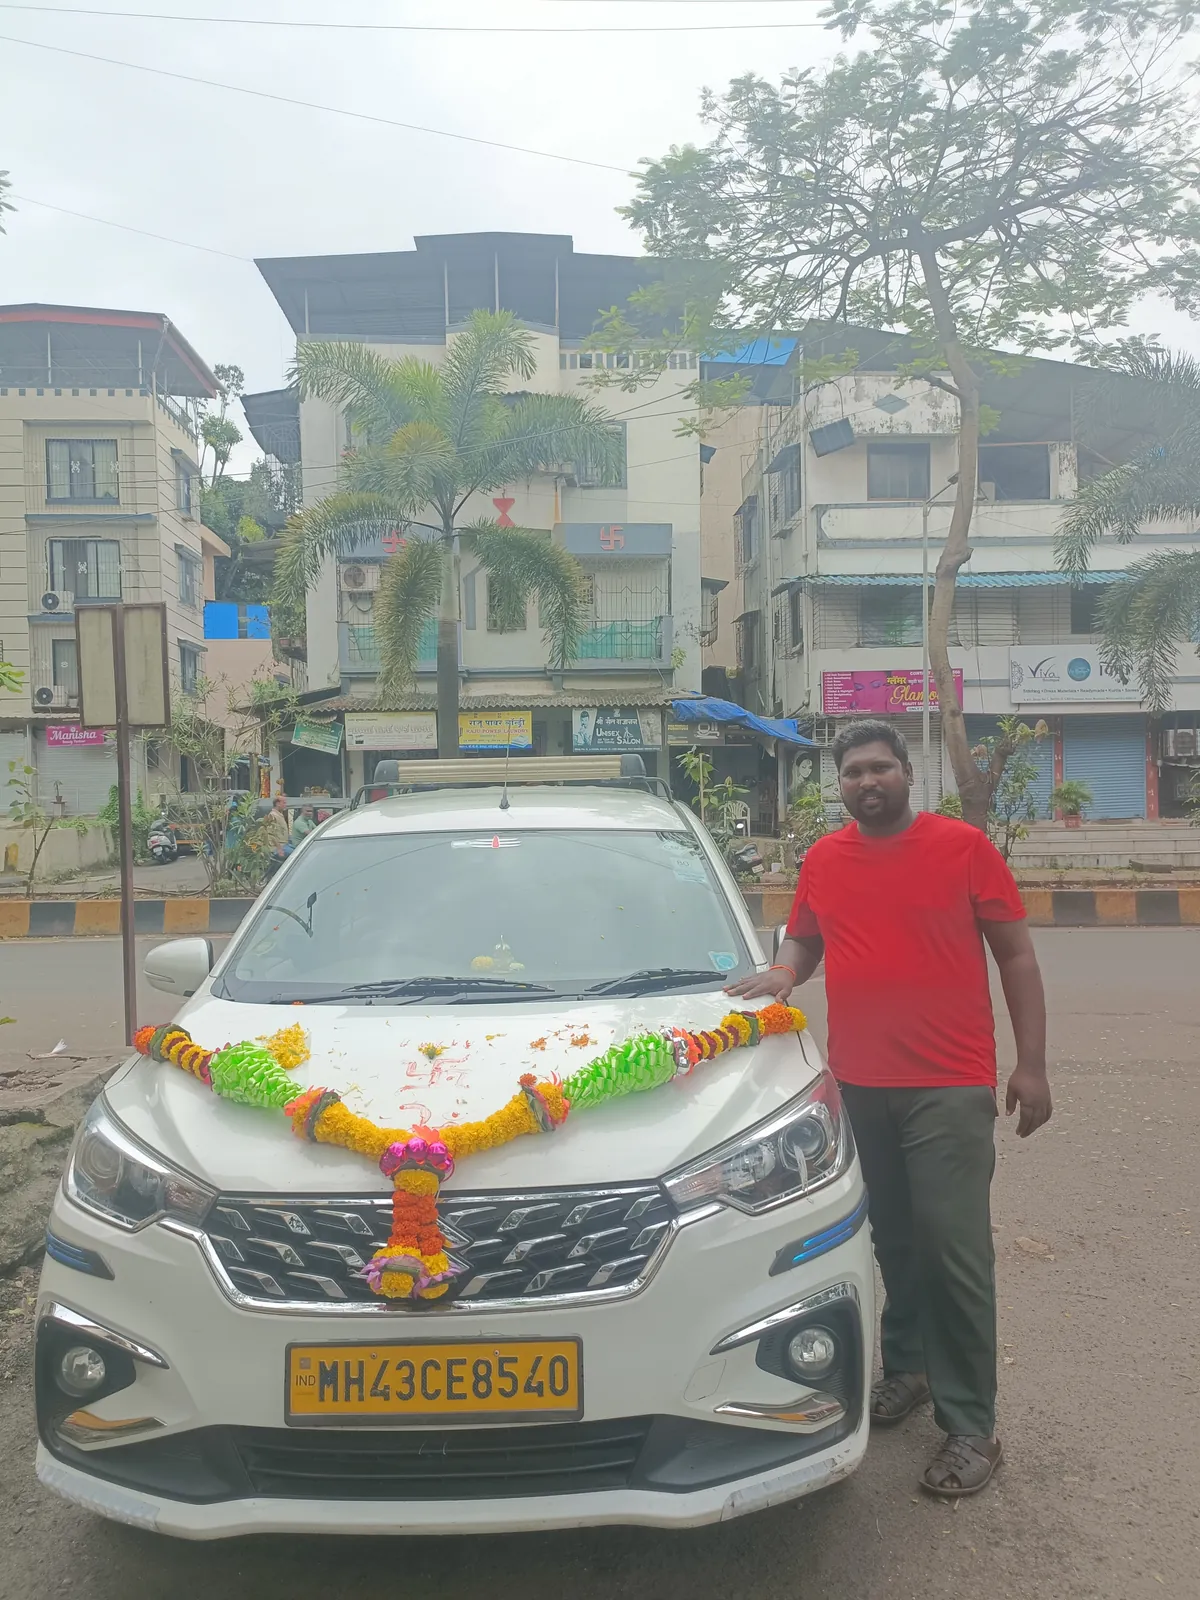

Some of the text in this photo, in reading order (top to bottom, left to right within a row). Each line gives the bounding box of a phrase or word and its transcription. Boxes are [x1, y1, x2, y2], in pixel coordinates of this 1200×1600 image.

[1027, 656, 1057, 678] Viva
[50, 730, 98, 741] Manisha
[616, 735, 641, 745] SALON
[295, 1354, 570, 1403] IND MH43CE8540
